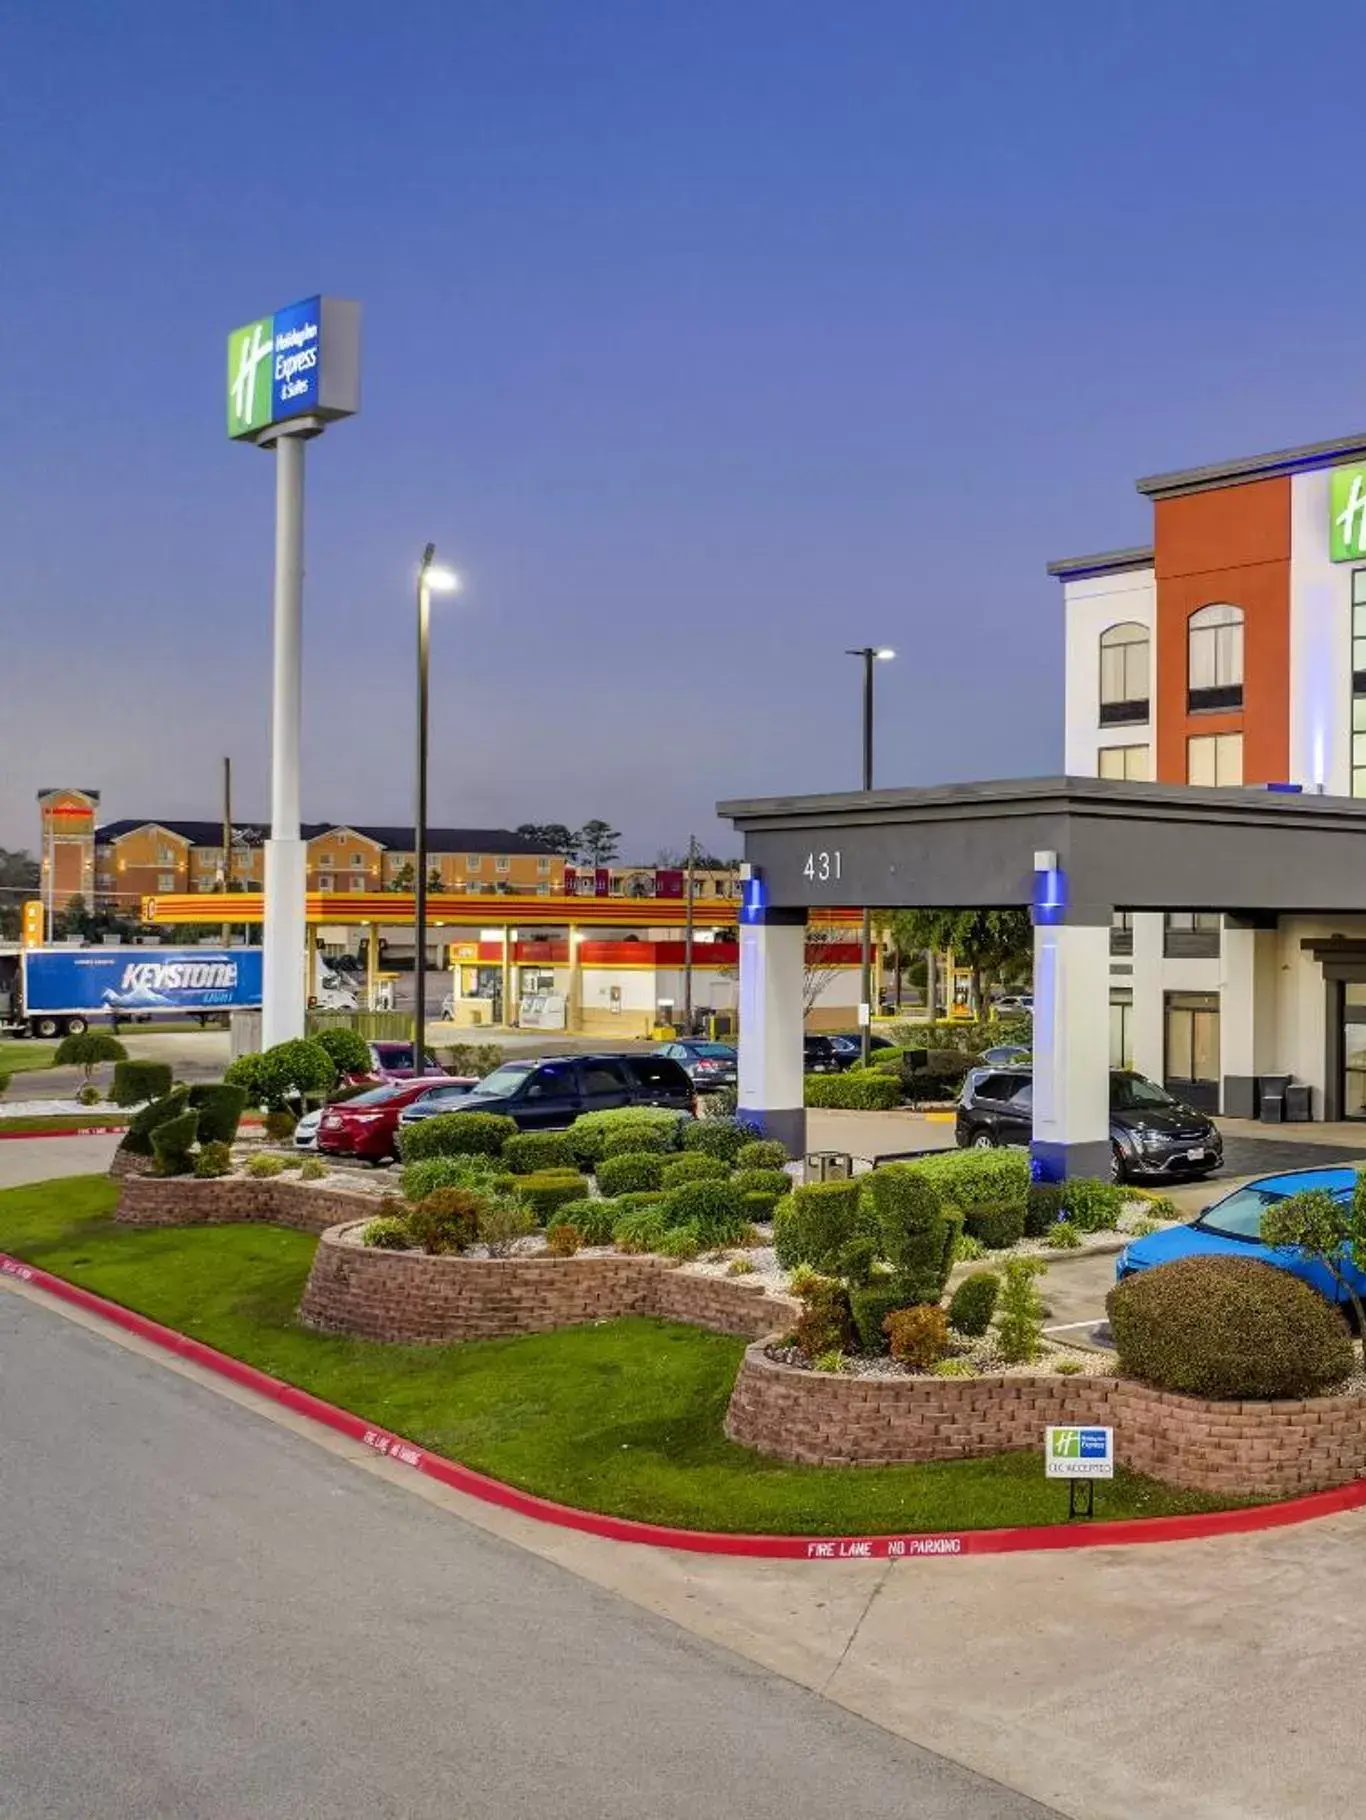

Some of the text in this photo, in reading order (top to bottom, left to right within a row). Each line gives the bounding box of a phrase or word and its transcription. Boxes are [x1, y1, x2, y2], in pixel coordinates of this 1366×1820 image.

[275, 347, 318, 382] Express
[803, 851, 841, 881] 431
[807, 1538, 961, 1557] FIRE LANE NO PARKING
